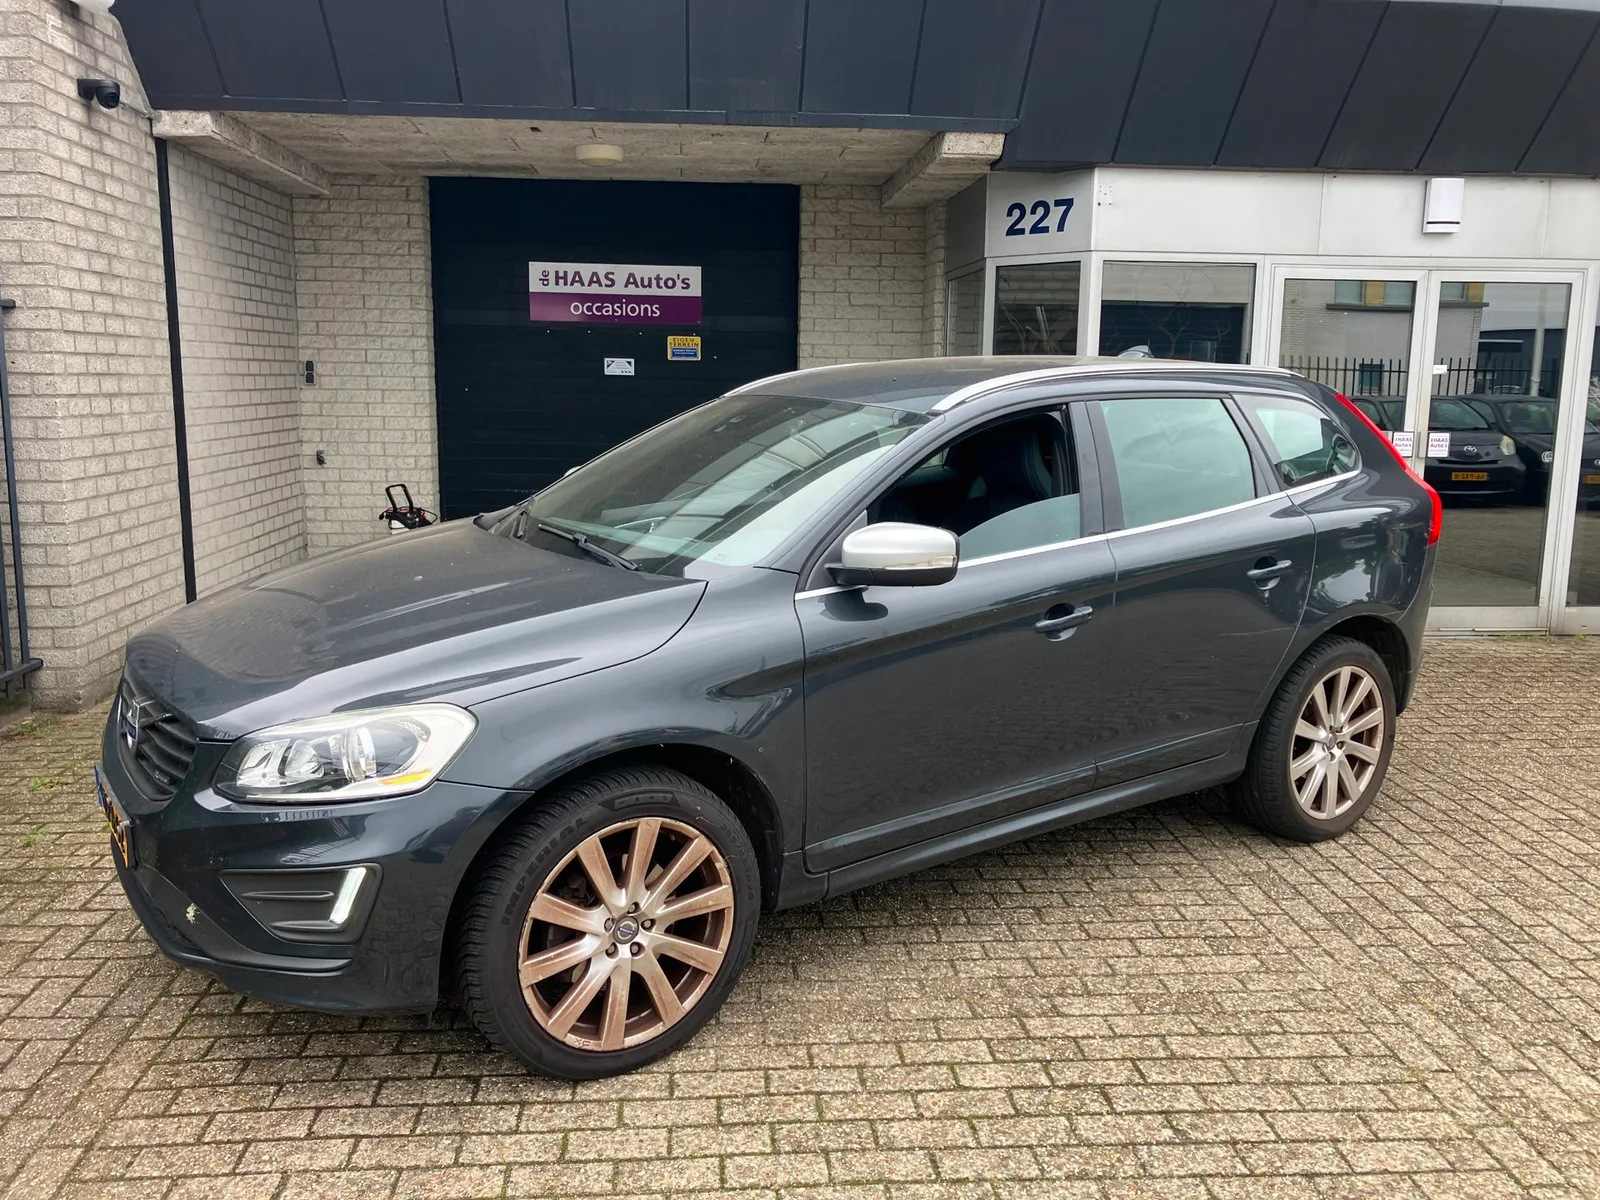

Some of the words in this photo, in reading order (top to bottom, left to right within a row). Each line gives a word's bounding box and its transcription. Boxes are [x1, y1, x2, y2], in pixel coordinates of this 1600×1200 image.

[1005, 198, 1074, 236] 227
[539, 269, 550, 287] de
[554, 270, 616, 288] HAAS
[624, 272, 691, 290] Auto's
[570, 299, 660, 317] occasions
[501, 818, 588, 925] IMPERIAL
